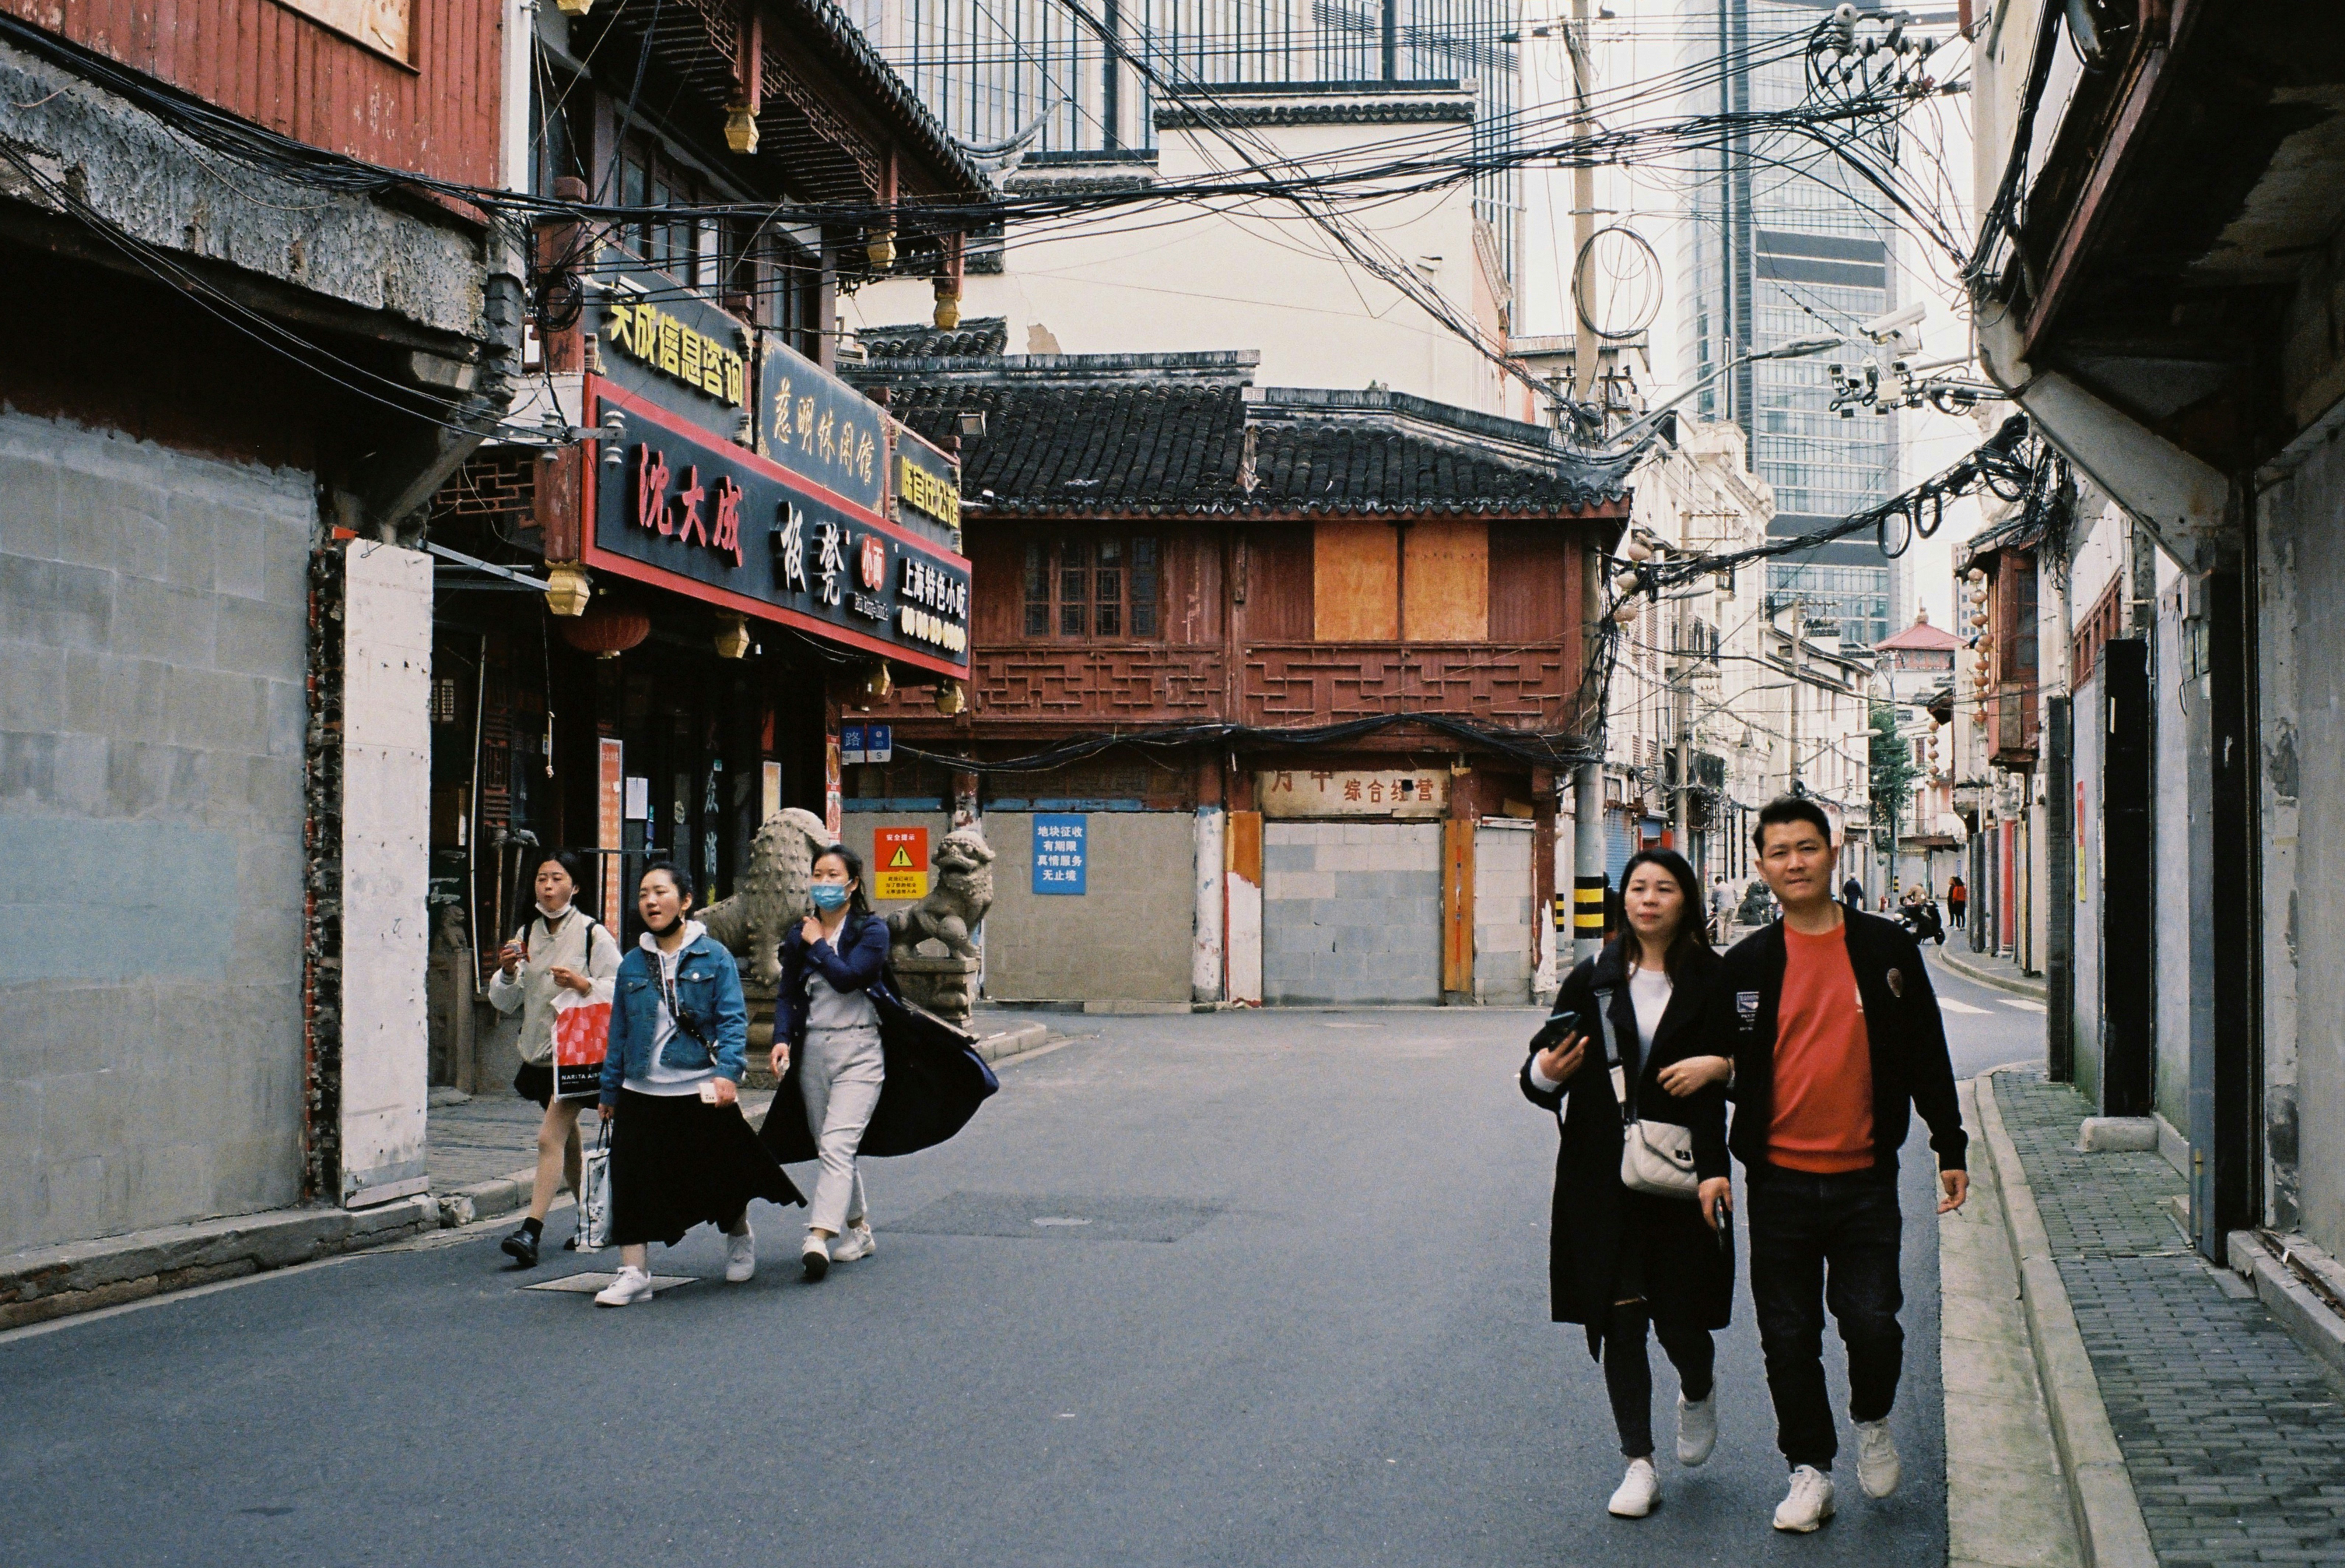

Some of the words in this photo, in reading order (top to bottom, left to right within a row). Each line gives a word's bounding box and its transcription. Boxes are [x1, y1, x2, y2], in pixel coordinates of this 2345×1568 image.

[639, 443, 743, 567] 沈大成
[902, 558, 966, 619] 上海特色小吃
[845, 731, 860, 746] 路
[1037, 826, 1083, 837] 地块征收
[1043, 840, 1077, 851] 有期限
[1037, 855, 1082, 866] 真情服务
[1043, 869, 1077, 881] 无止境
